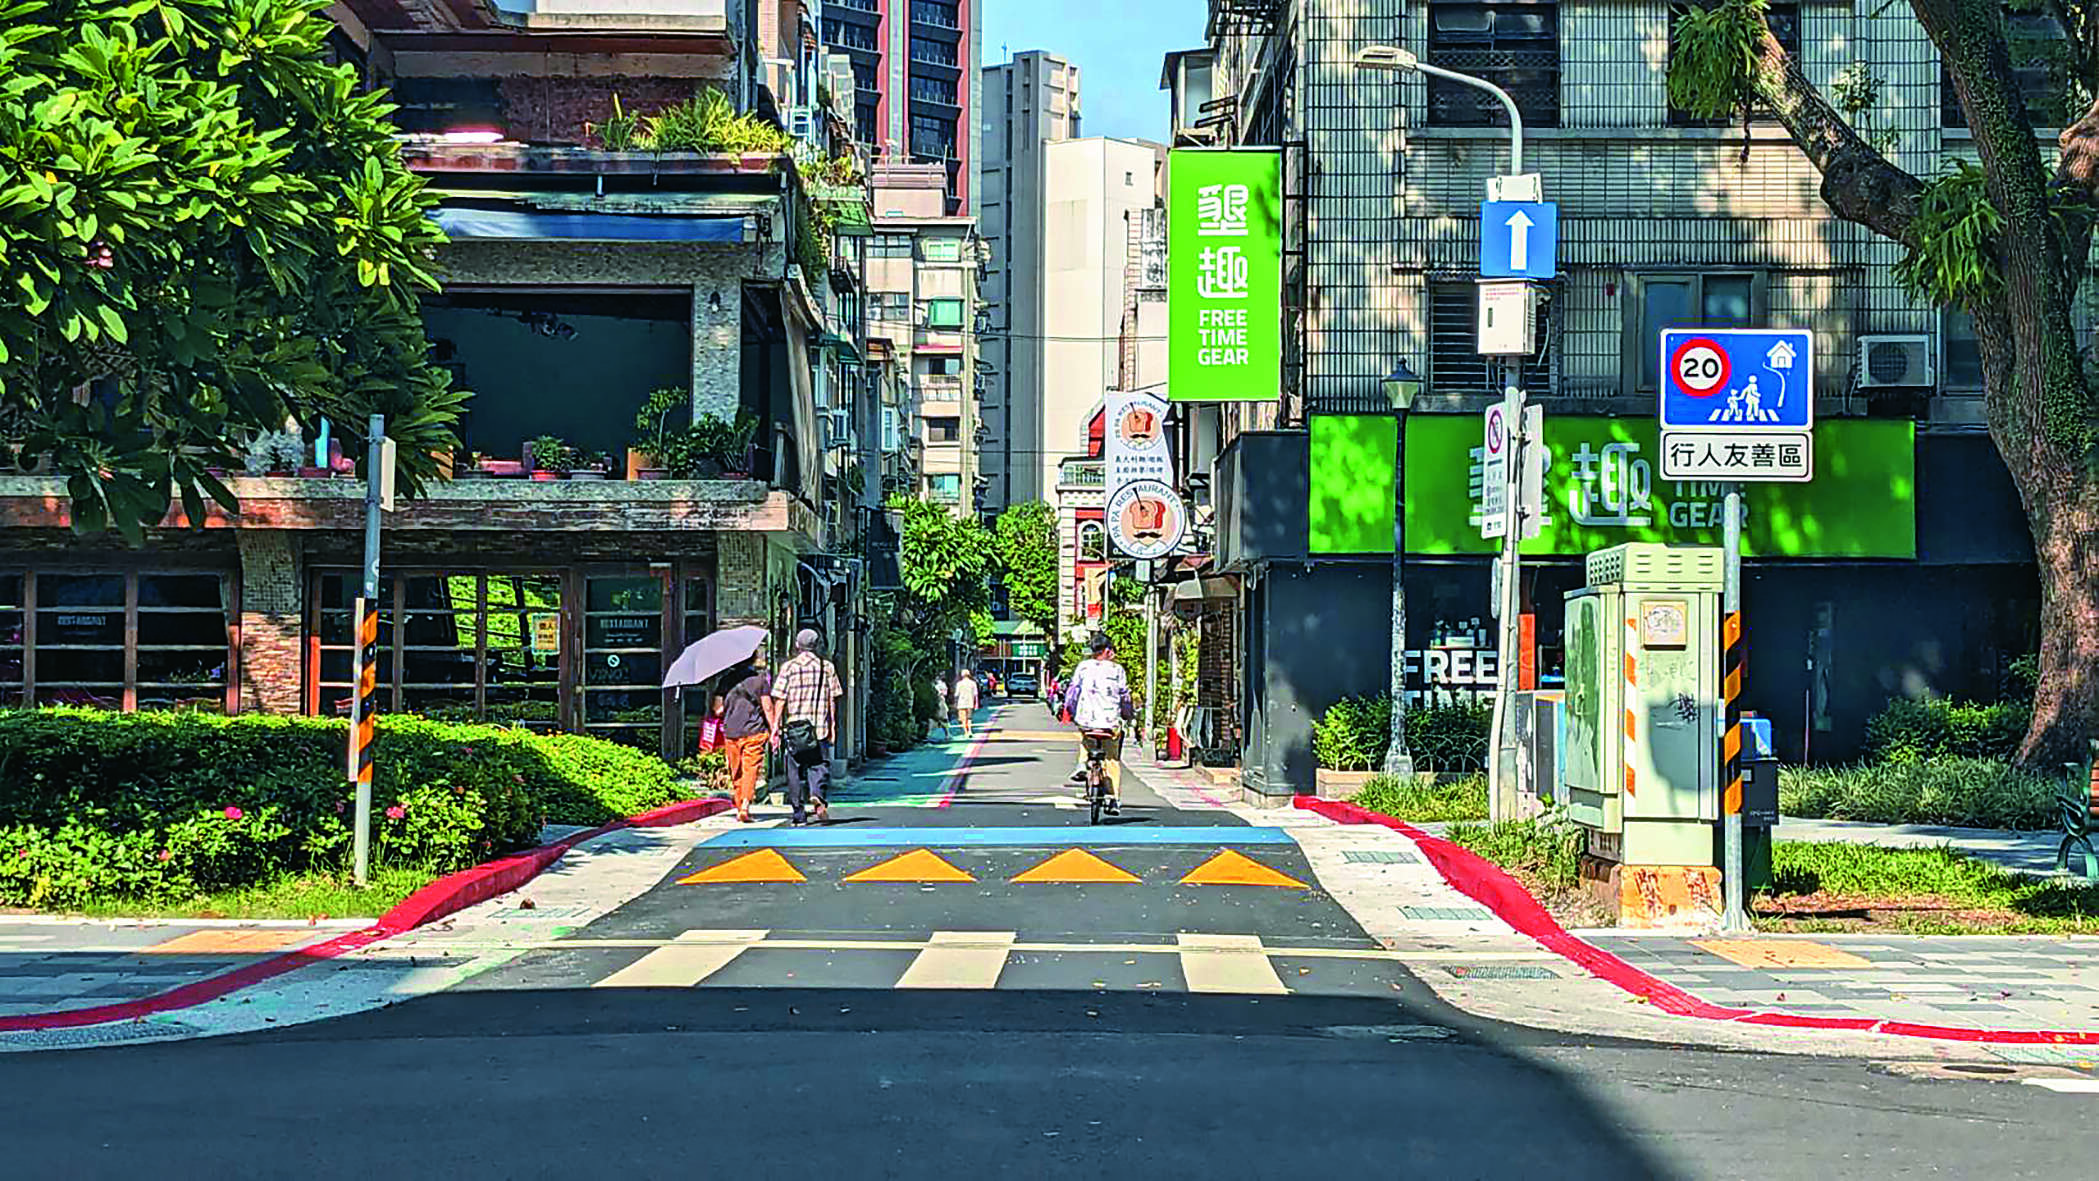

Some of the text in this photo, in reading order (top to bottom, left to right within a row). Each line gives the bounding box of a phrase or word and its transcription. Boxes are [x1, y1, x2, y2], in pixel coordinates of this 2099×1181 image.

[1197, 184, 1248, 298] 墾趣
[1199, 309, 1248, 326] FREE
[1198, 328, 1248, 345] TIME
[1198, 348, 1248, 365] GEAR
[1683, 358, 1719, 378] 20
[1670, 442, 1803, 468] 行人友善區
[1111, 511, 1120, 522] PA
[1116, 484, 1179, 507] RESAURANT
[1404, 650, 1499, 684] FREE
